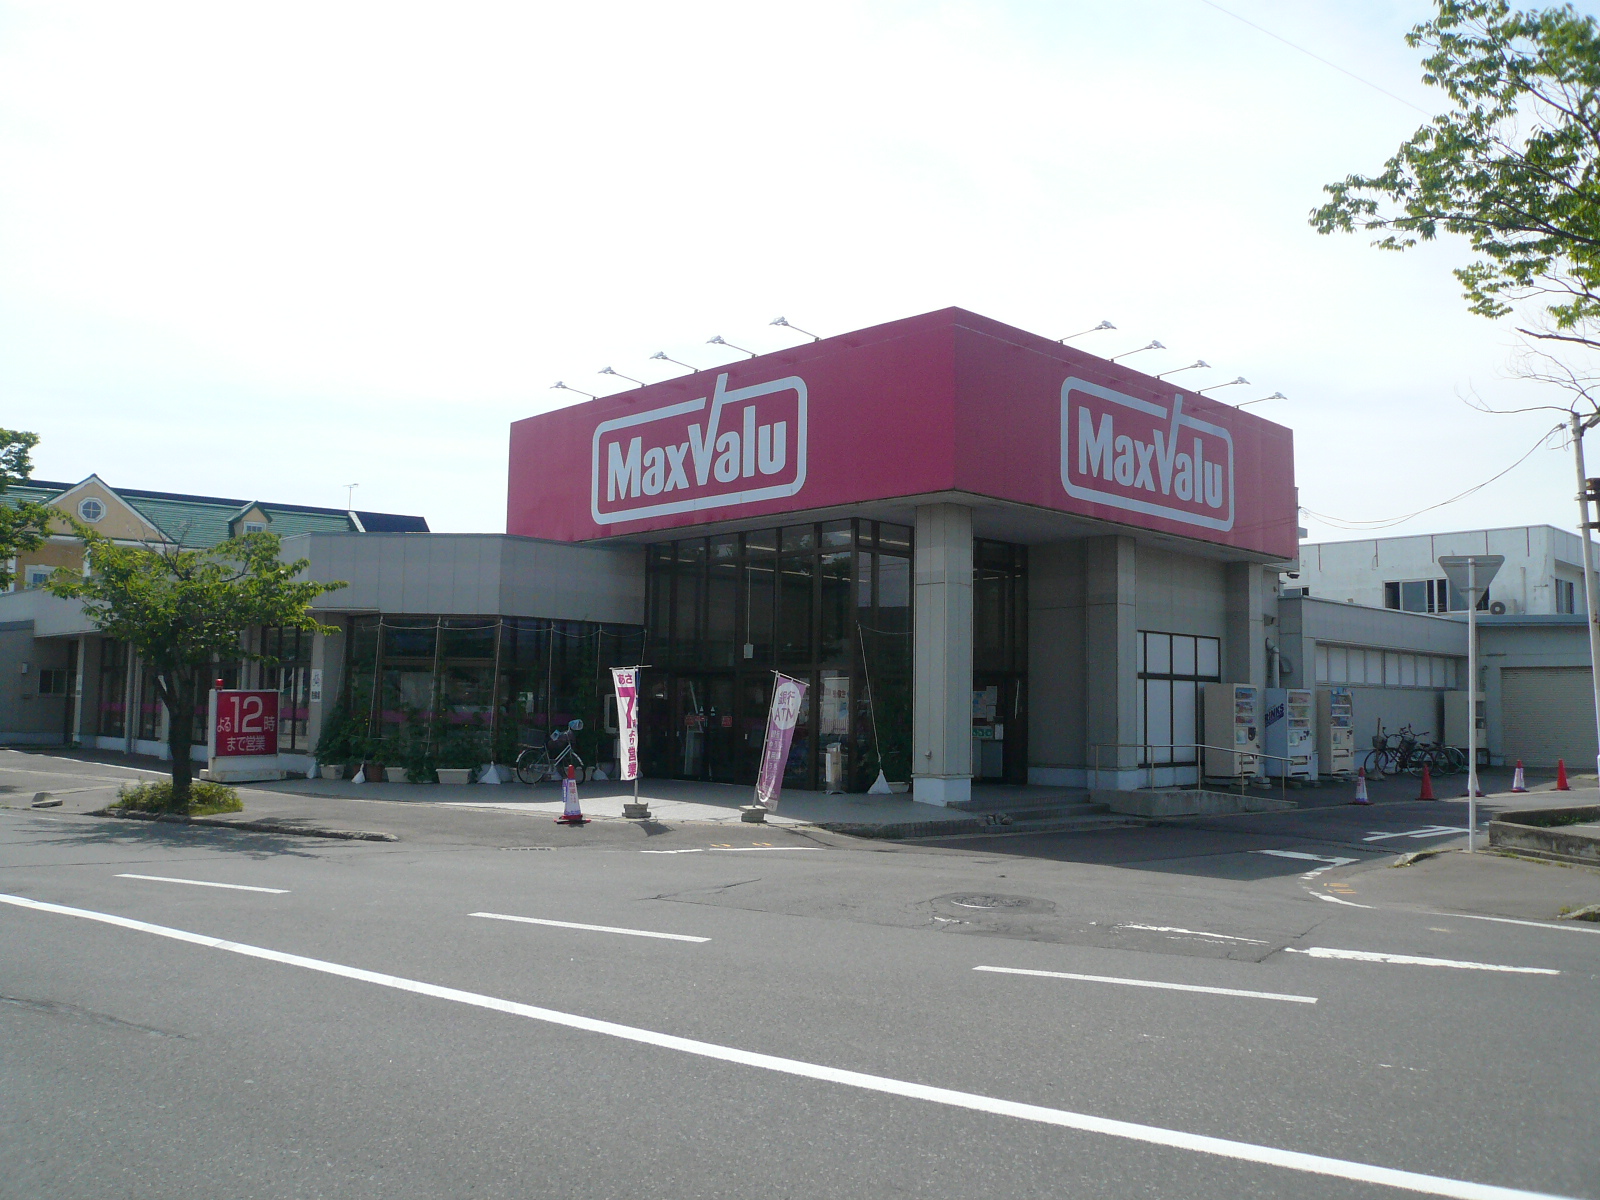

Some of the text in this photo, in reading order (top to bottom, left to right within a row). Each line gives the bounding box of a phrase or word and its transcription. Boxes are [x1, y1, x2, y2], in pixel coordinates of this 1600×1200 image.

[607, 372, 787, 502] MaxValu
[1078, 392, 1223, 509] MaxValu
[226, 735, 266, 752] まで営業
